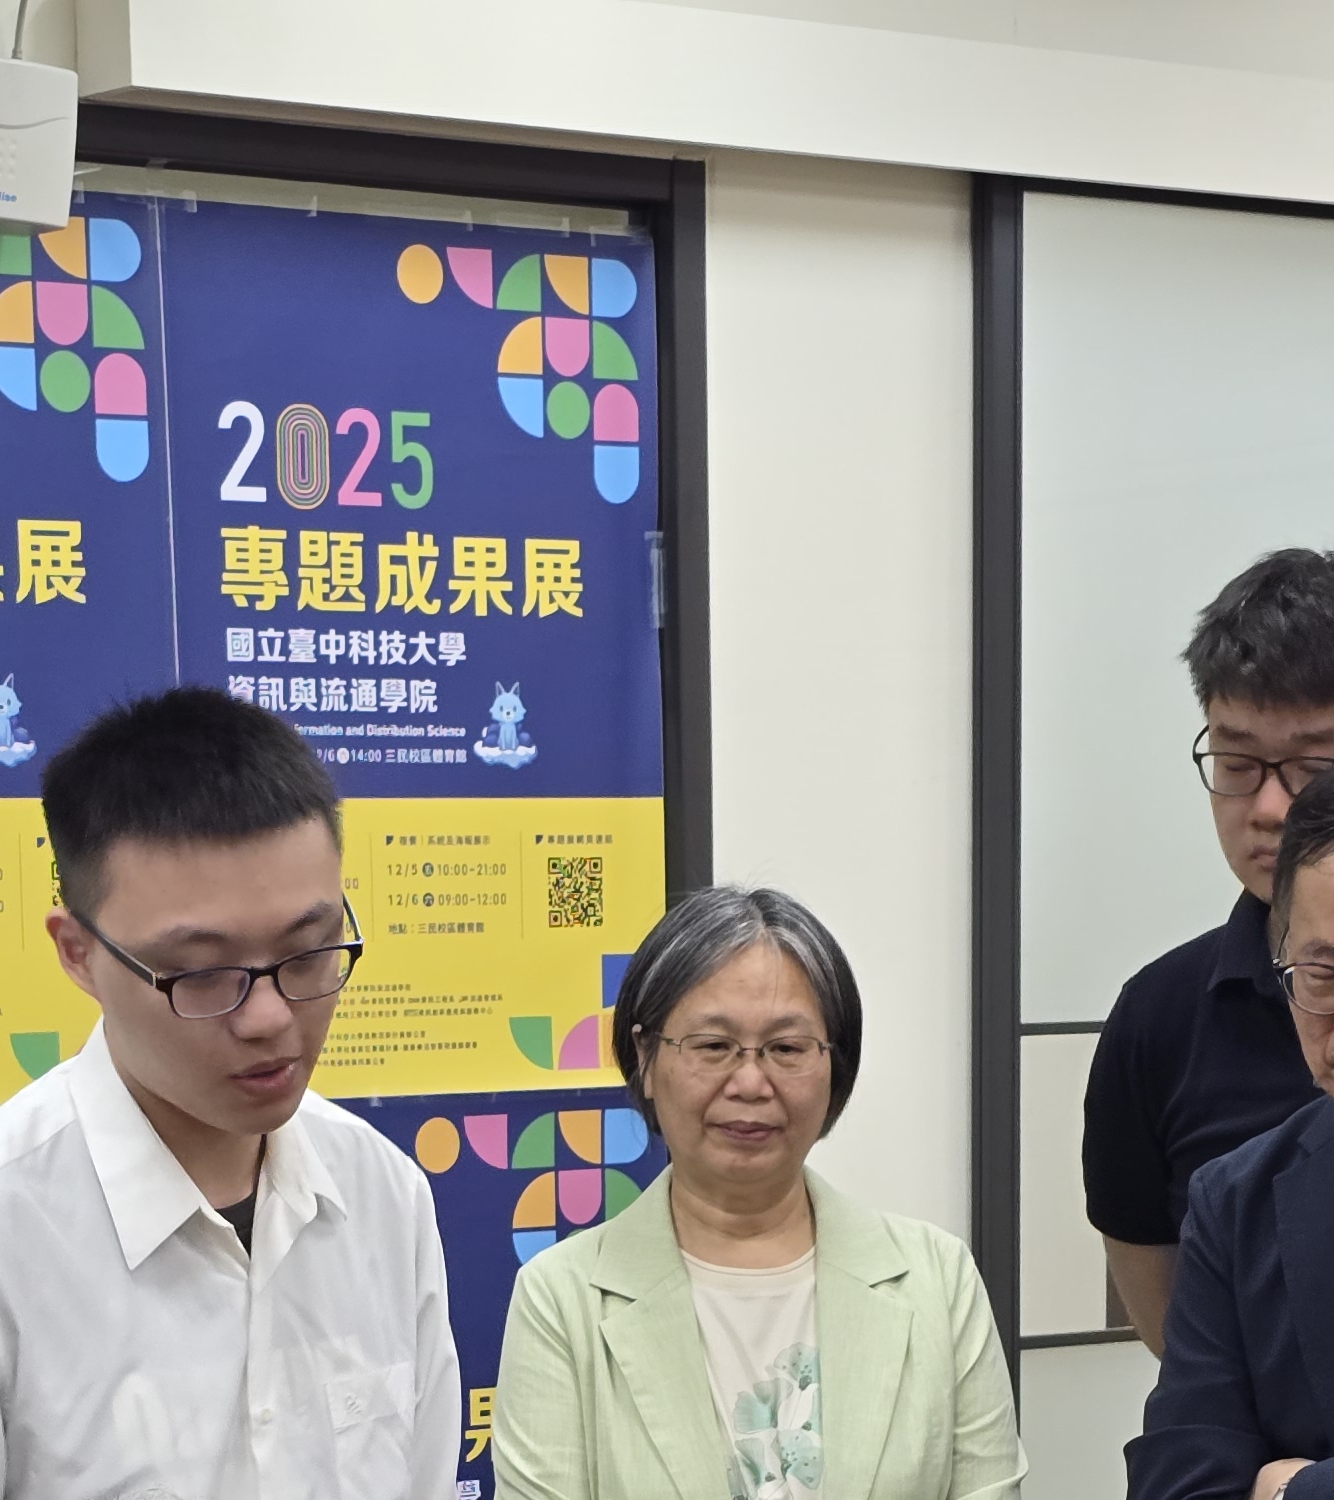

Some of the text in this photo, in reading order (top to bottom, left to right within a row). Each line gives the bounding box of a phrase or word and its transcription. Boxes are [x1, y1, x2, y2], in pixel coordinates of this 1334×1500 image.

[217, 400, 435, 510] 2025
[220, 525, 584, 618] 專題成果展
[226, 626, 468, 667] 國立臺中科技大學
[227, 674, 438, 713] 資訊與流通學院
[346, 723, 365, 736] and
[366, 723, 425, 737] Distribution
[427, 724, 467, 737] Science
